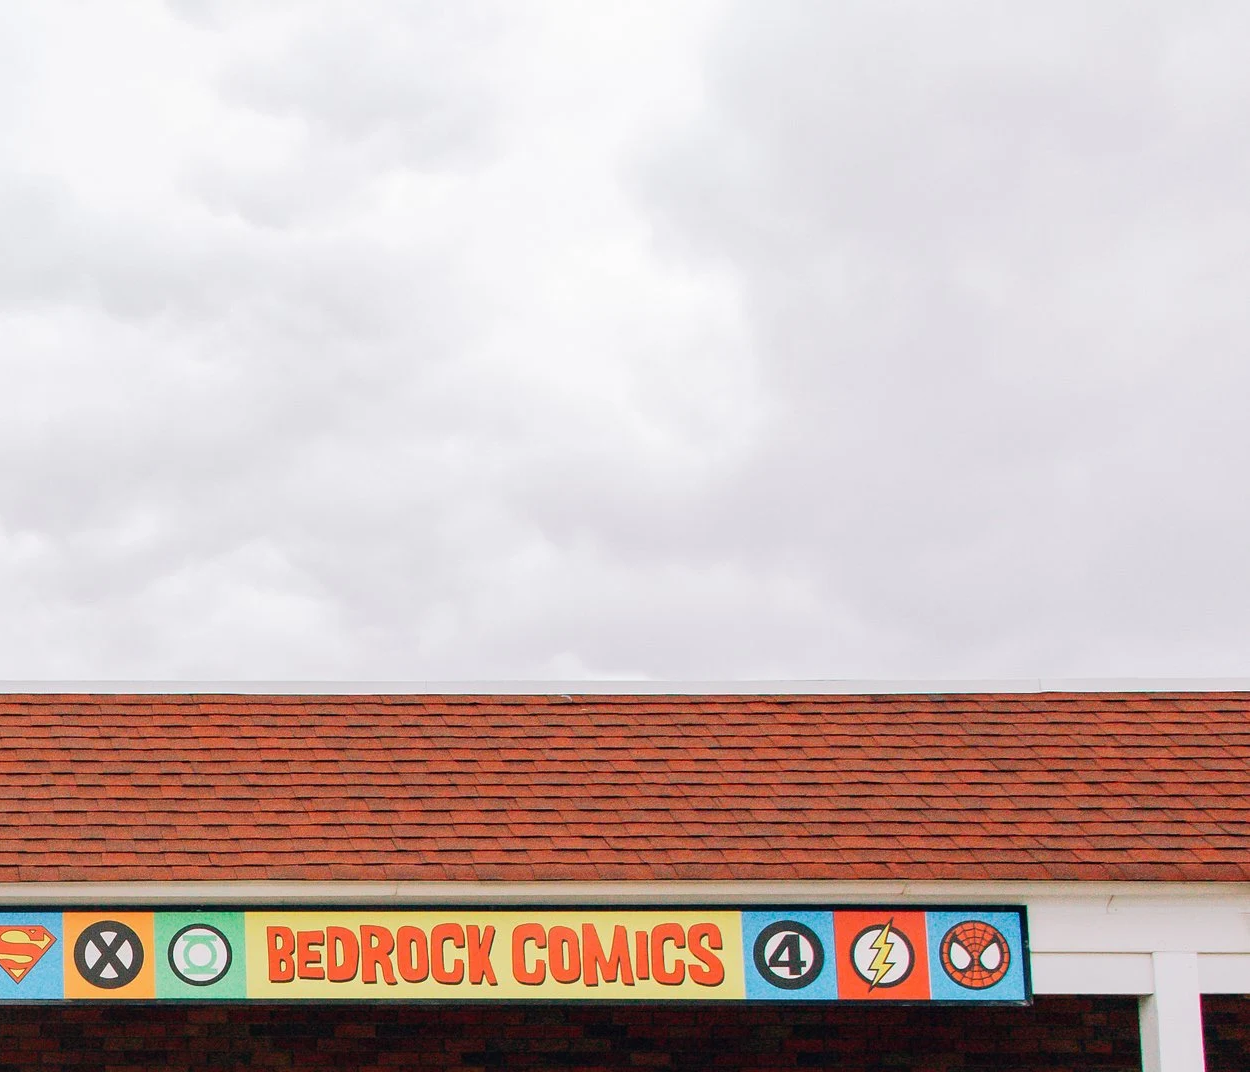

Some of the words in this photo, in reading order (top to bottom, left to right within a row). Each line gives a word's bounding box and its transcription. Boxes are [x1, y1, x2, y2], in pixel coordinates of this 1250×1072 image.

[266, 923, 498, 986] BEDROCK
[511, 921, 725, 987] COMICS
[768, 934, 807, 976] 4
